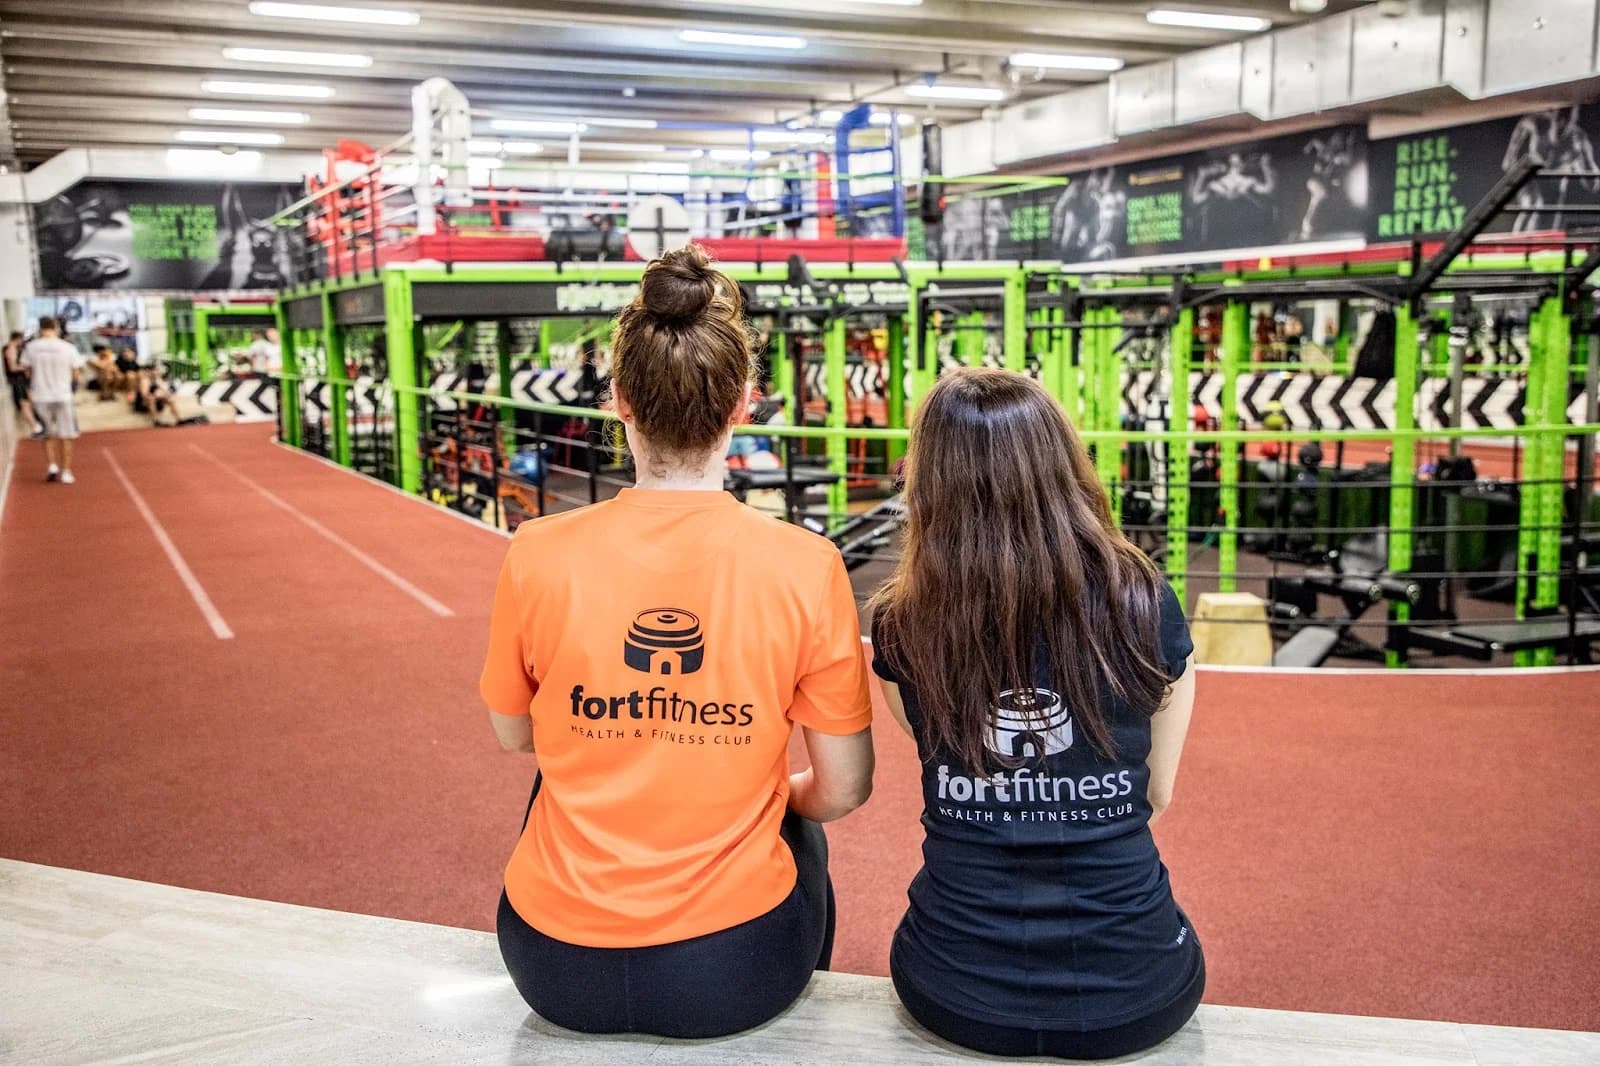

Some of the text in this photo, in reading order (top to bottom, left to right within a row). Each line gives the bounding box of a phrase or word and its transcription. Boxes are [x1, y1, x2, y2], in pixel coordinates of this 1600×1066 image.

[1397, 136, 1458, 163] RISE.
[1395, 162, 1457, 187] RUN.
[1394, 185, 1457, 210] REST.
[571, 685, 753, 726] fortfitness
[571, 725, 751, 746] HEALTH & FITNESS CLUB
[938, 765, 1132, 802] fortfitness
[939, 803, 1133, 821] HEALTH & FITNESS CLUB
